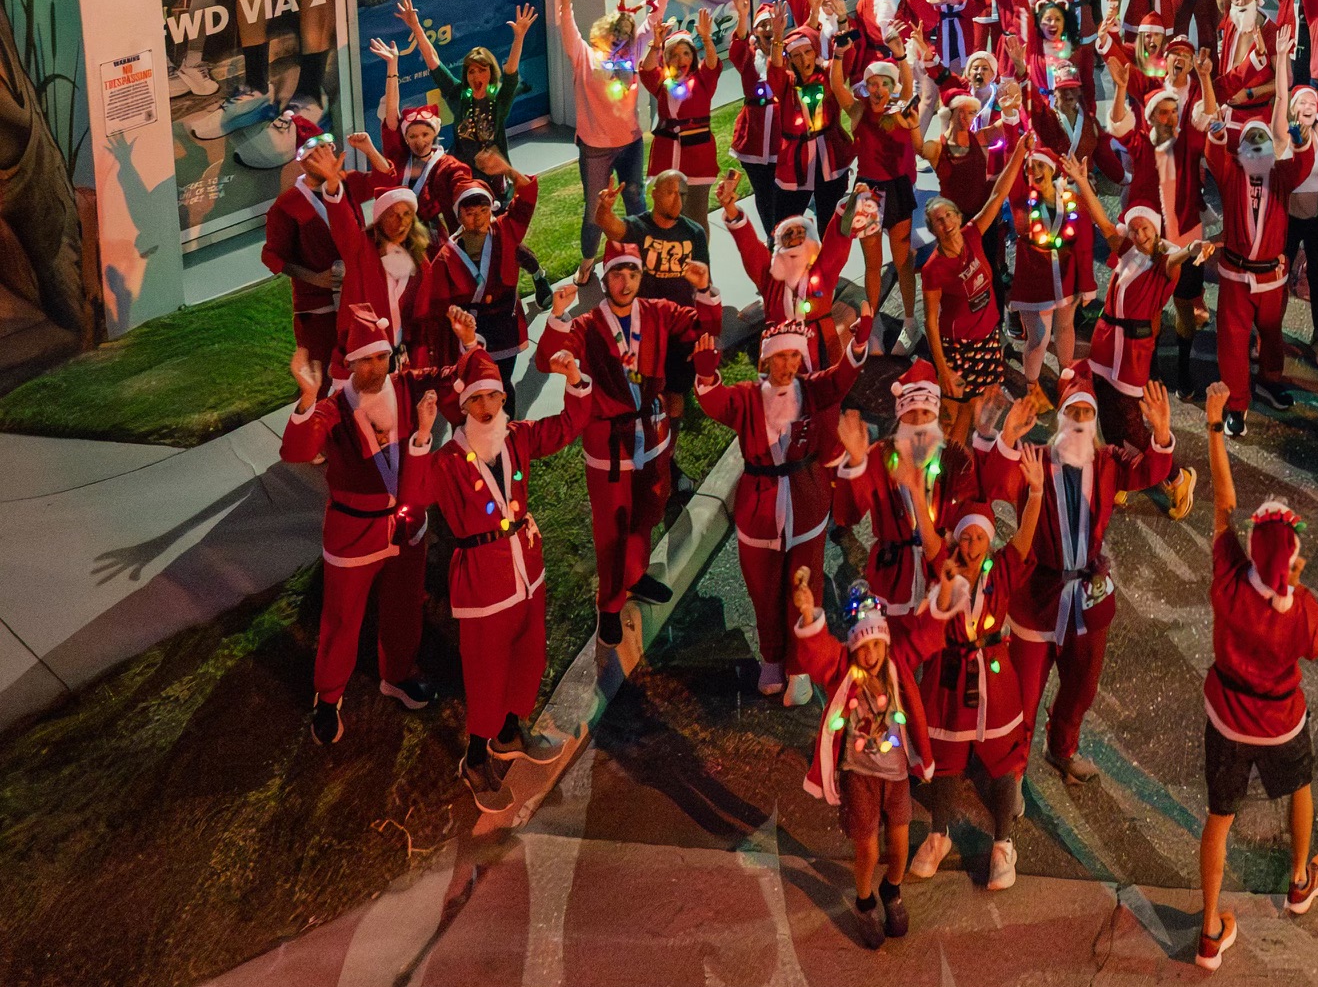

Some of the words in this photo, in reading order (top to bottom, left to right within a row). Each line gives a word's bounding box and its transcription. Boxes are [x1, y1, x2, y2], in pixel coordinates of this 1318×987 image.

[163, 5, 229, 44] WD
[104, 68, 153, 91] TRESPASSING
[122, 64, 133, 76] NO
